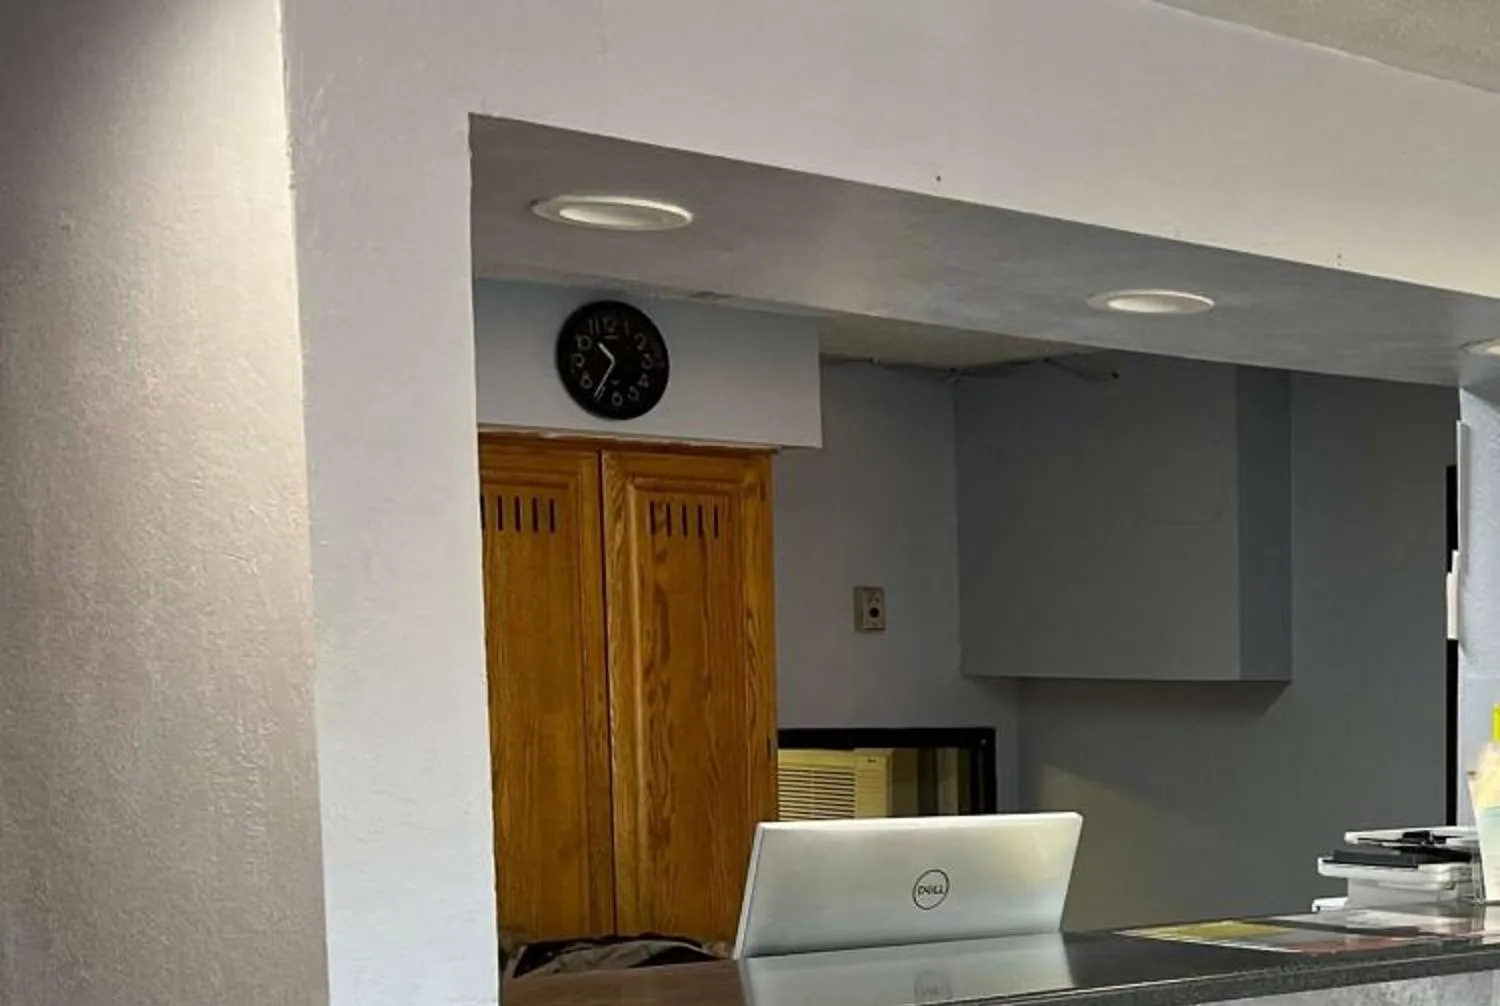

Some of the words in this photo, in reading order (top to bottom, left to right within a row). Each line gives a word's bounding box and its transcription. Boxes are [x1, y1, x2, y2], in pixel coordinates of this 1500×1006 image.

[602, 316, 618, 333] 12
[576, 333, 592, 351] 10
[634, 332, 647, 351] 2
[570, 353, 585, 374] 9
[641, 352, 653, 370] 3
[580, 370, 593, 390] 8
[637, 372, 651, 388] 4
[611, 389, 624, 407] 6
[627, 385, 640, 401] 5
[918, 884, 943, 895] DELL
